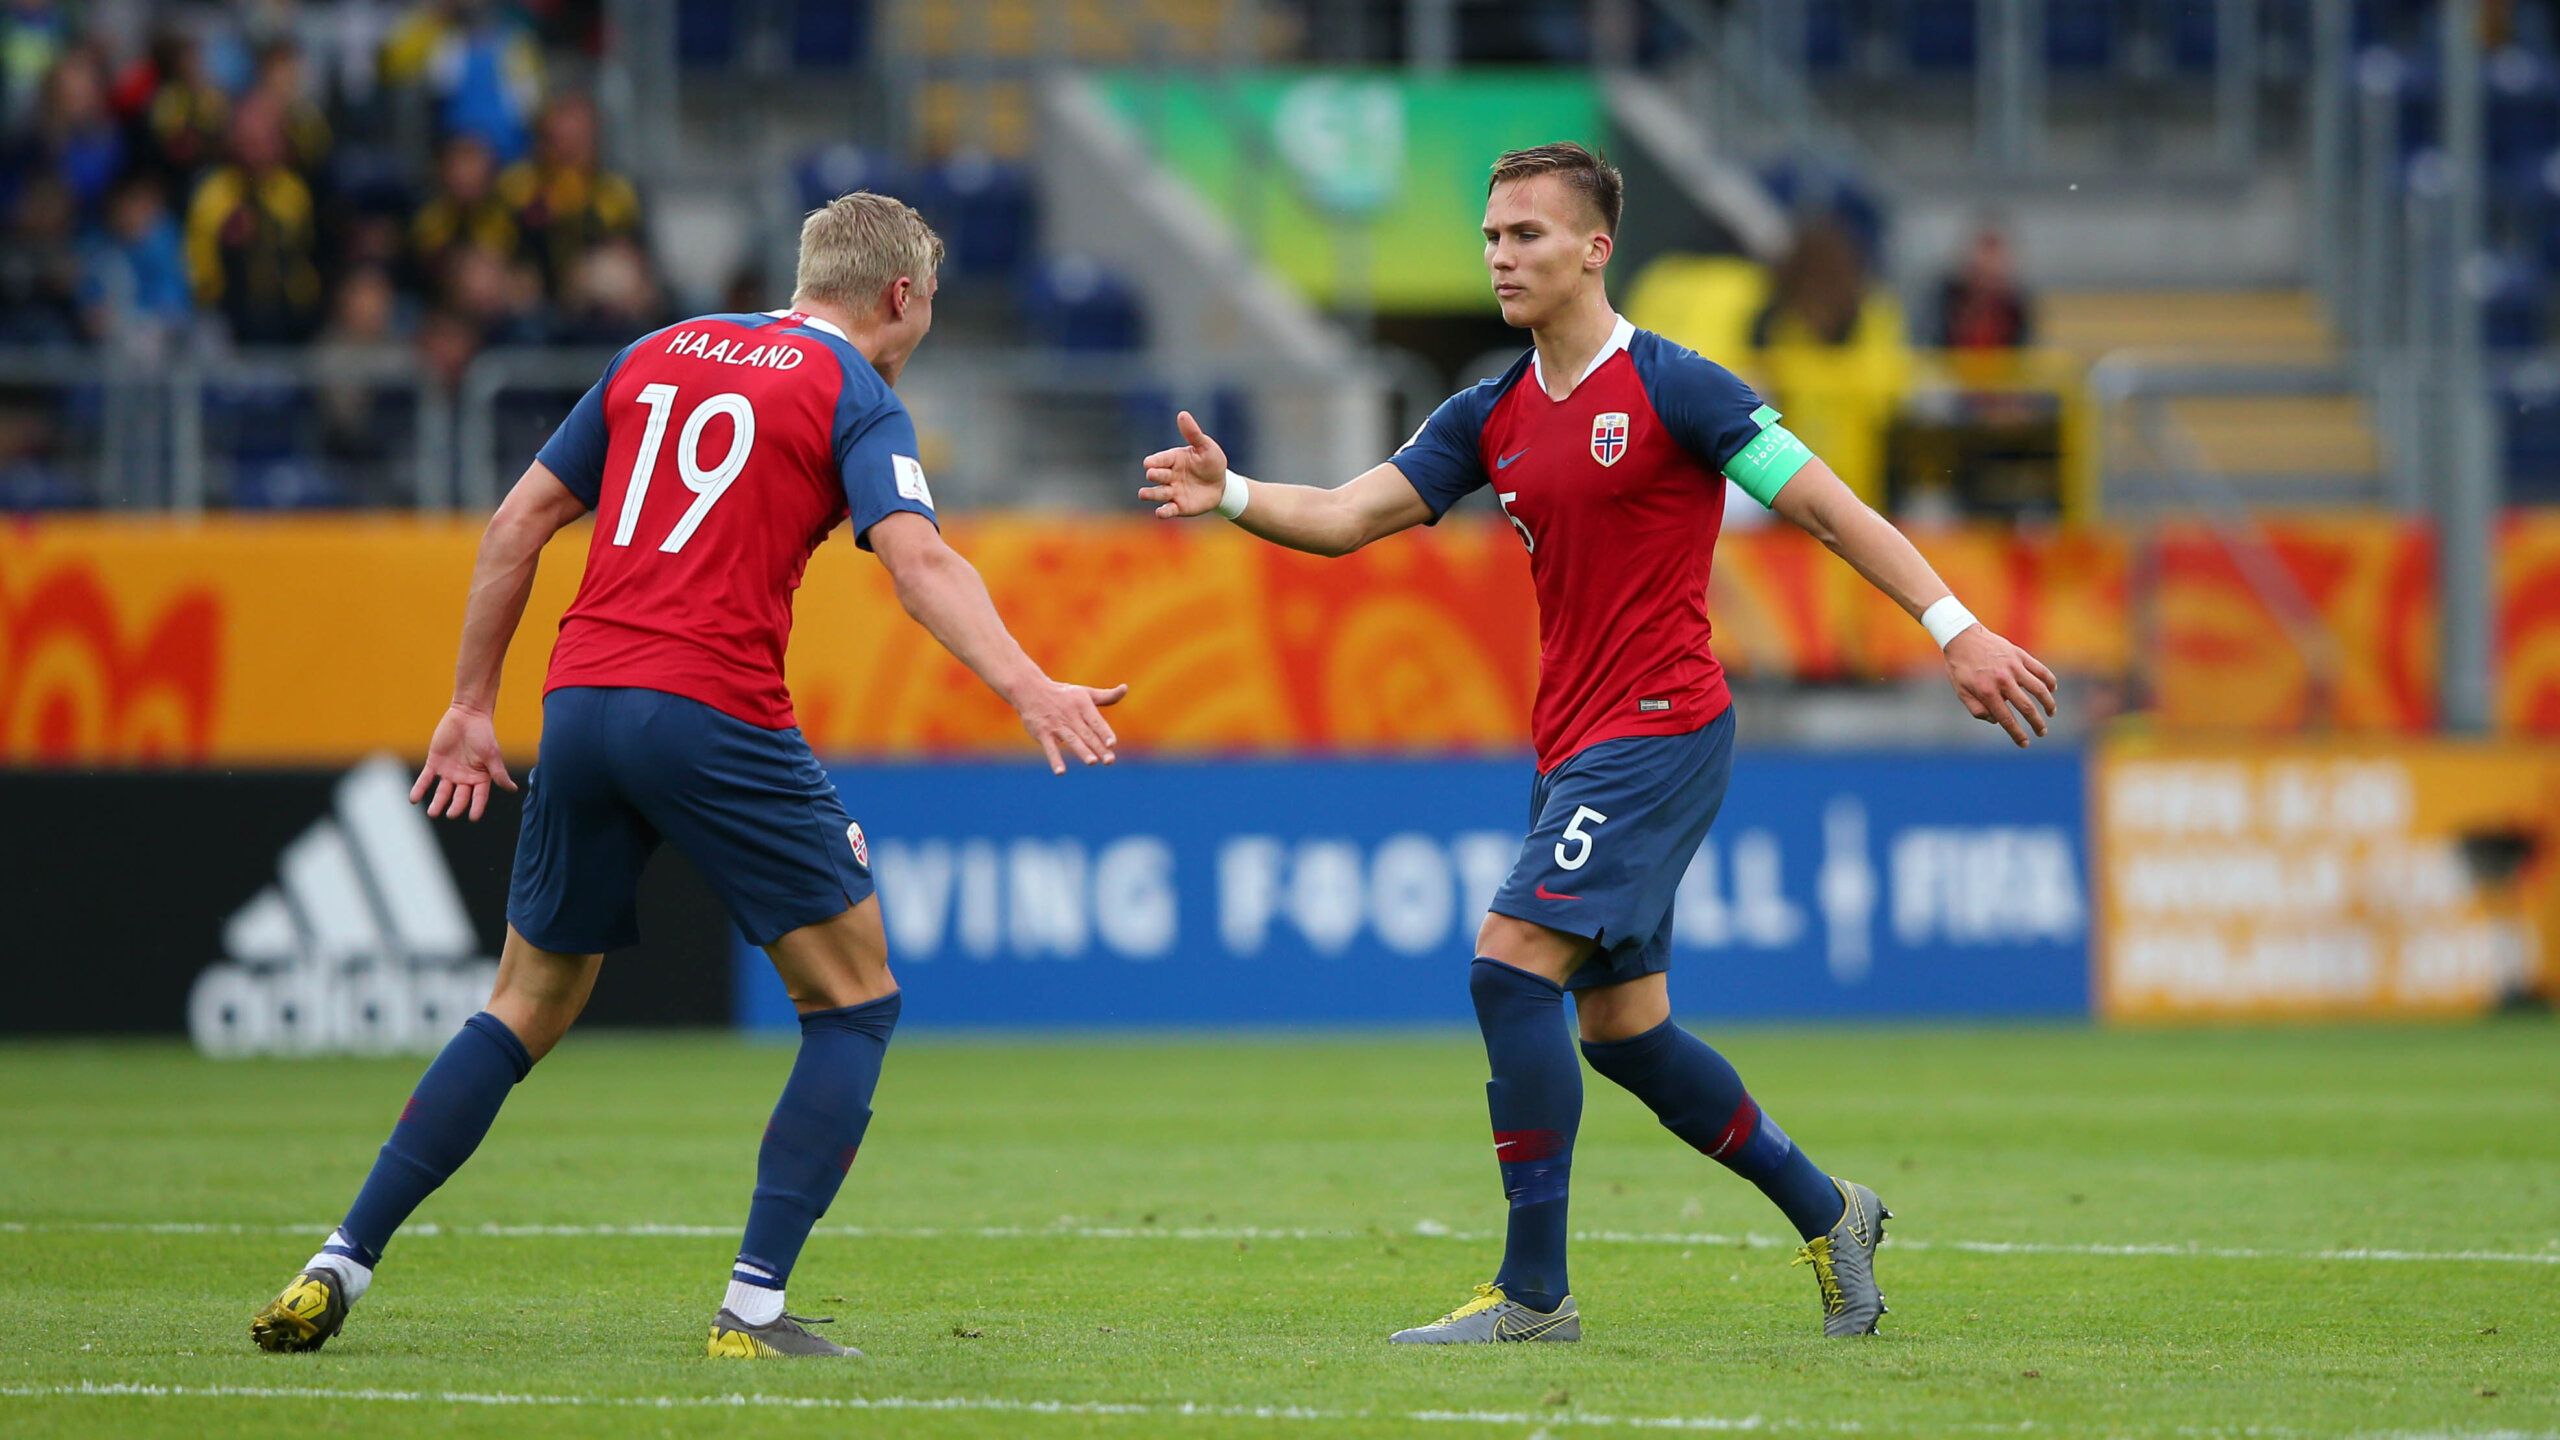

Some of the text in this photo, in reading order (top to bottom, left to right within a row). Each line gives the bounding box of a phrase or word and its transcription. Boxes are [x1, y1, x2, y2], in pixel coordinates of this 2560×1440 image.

[665, 330, 804, 370] HAALAND
[612, 382, 755, 554] 19
[1498, 491, 1535, 554] 5
[1553, 804, 1608, 871] 5
[876, 838, 1178, 958] VING
[1890, 828, 2085, 944] FIFA
